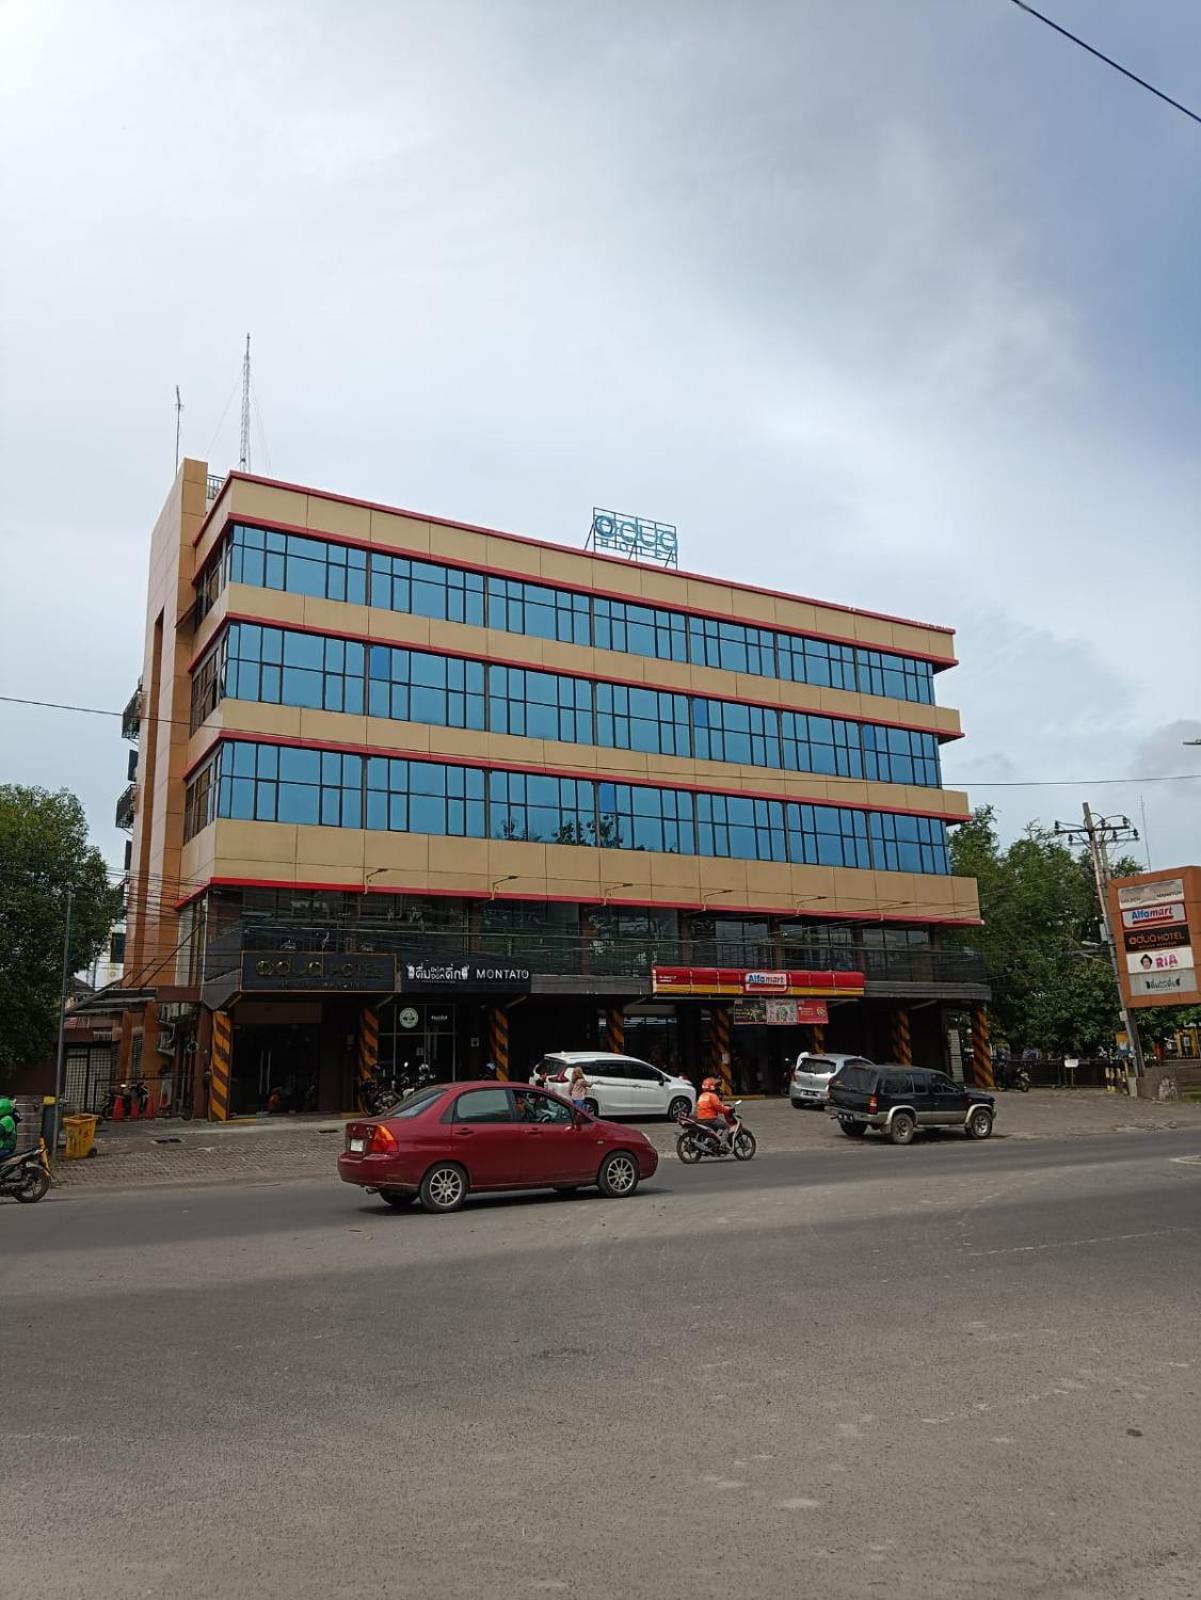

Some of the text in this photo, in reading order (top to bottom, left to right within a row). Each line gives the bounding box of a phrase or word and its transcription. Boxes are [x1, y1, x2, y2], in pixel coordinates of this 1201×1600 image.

[1131, 906, 1174, 920] Alfamart
[1157, 931, 1185, 943] HOTEL
[1155, 954, 1178, 968] RIA
[476, 968, 529, 980] MONTATO
[748, 974, 785, 984] Alfamart
